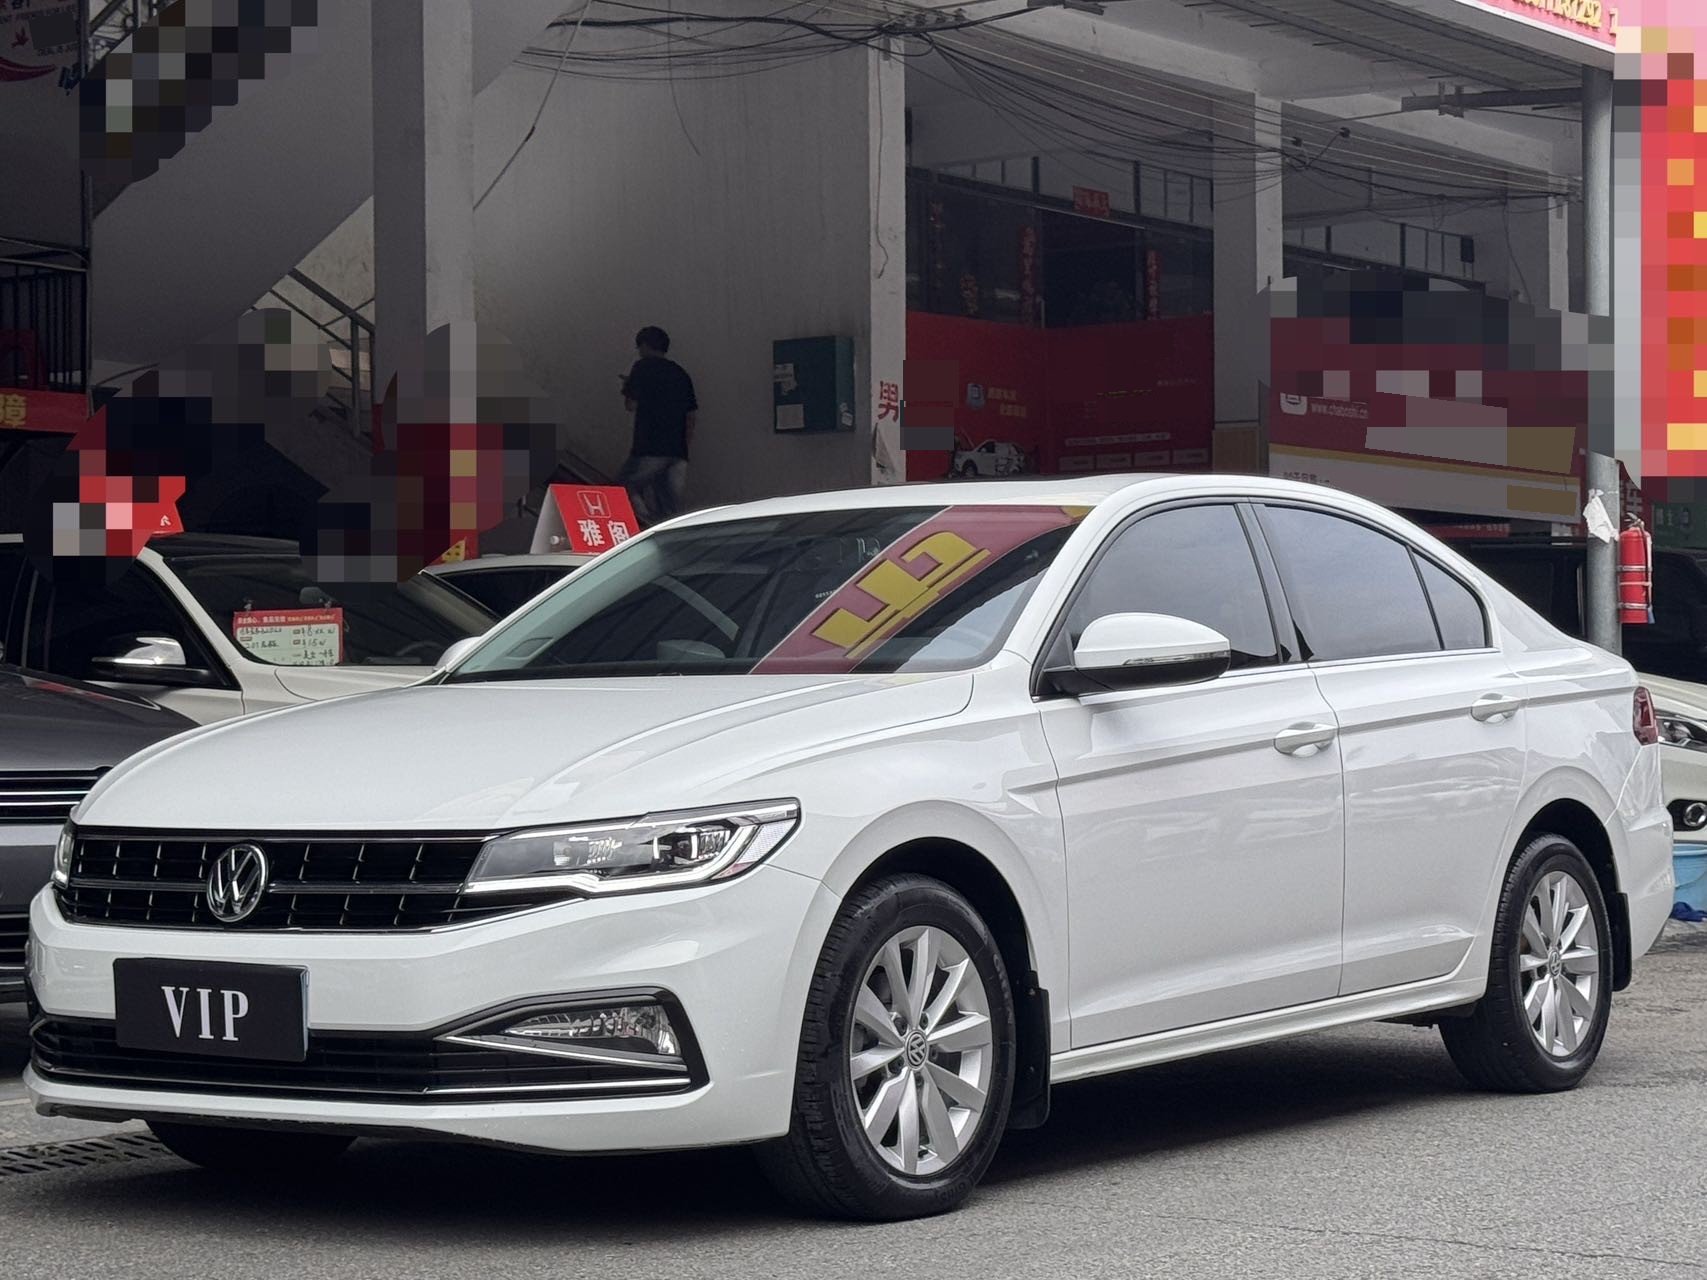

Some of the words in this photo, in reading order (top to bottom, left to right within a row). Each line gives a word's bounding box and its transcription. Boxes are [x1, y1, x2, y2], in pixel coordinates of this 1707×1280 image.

[878, 381, 899, 423] 男
[577, 519, 630, 547] 雅阁
[161, 986, 249, 1041] VIP
